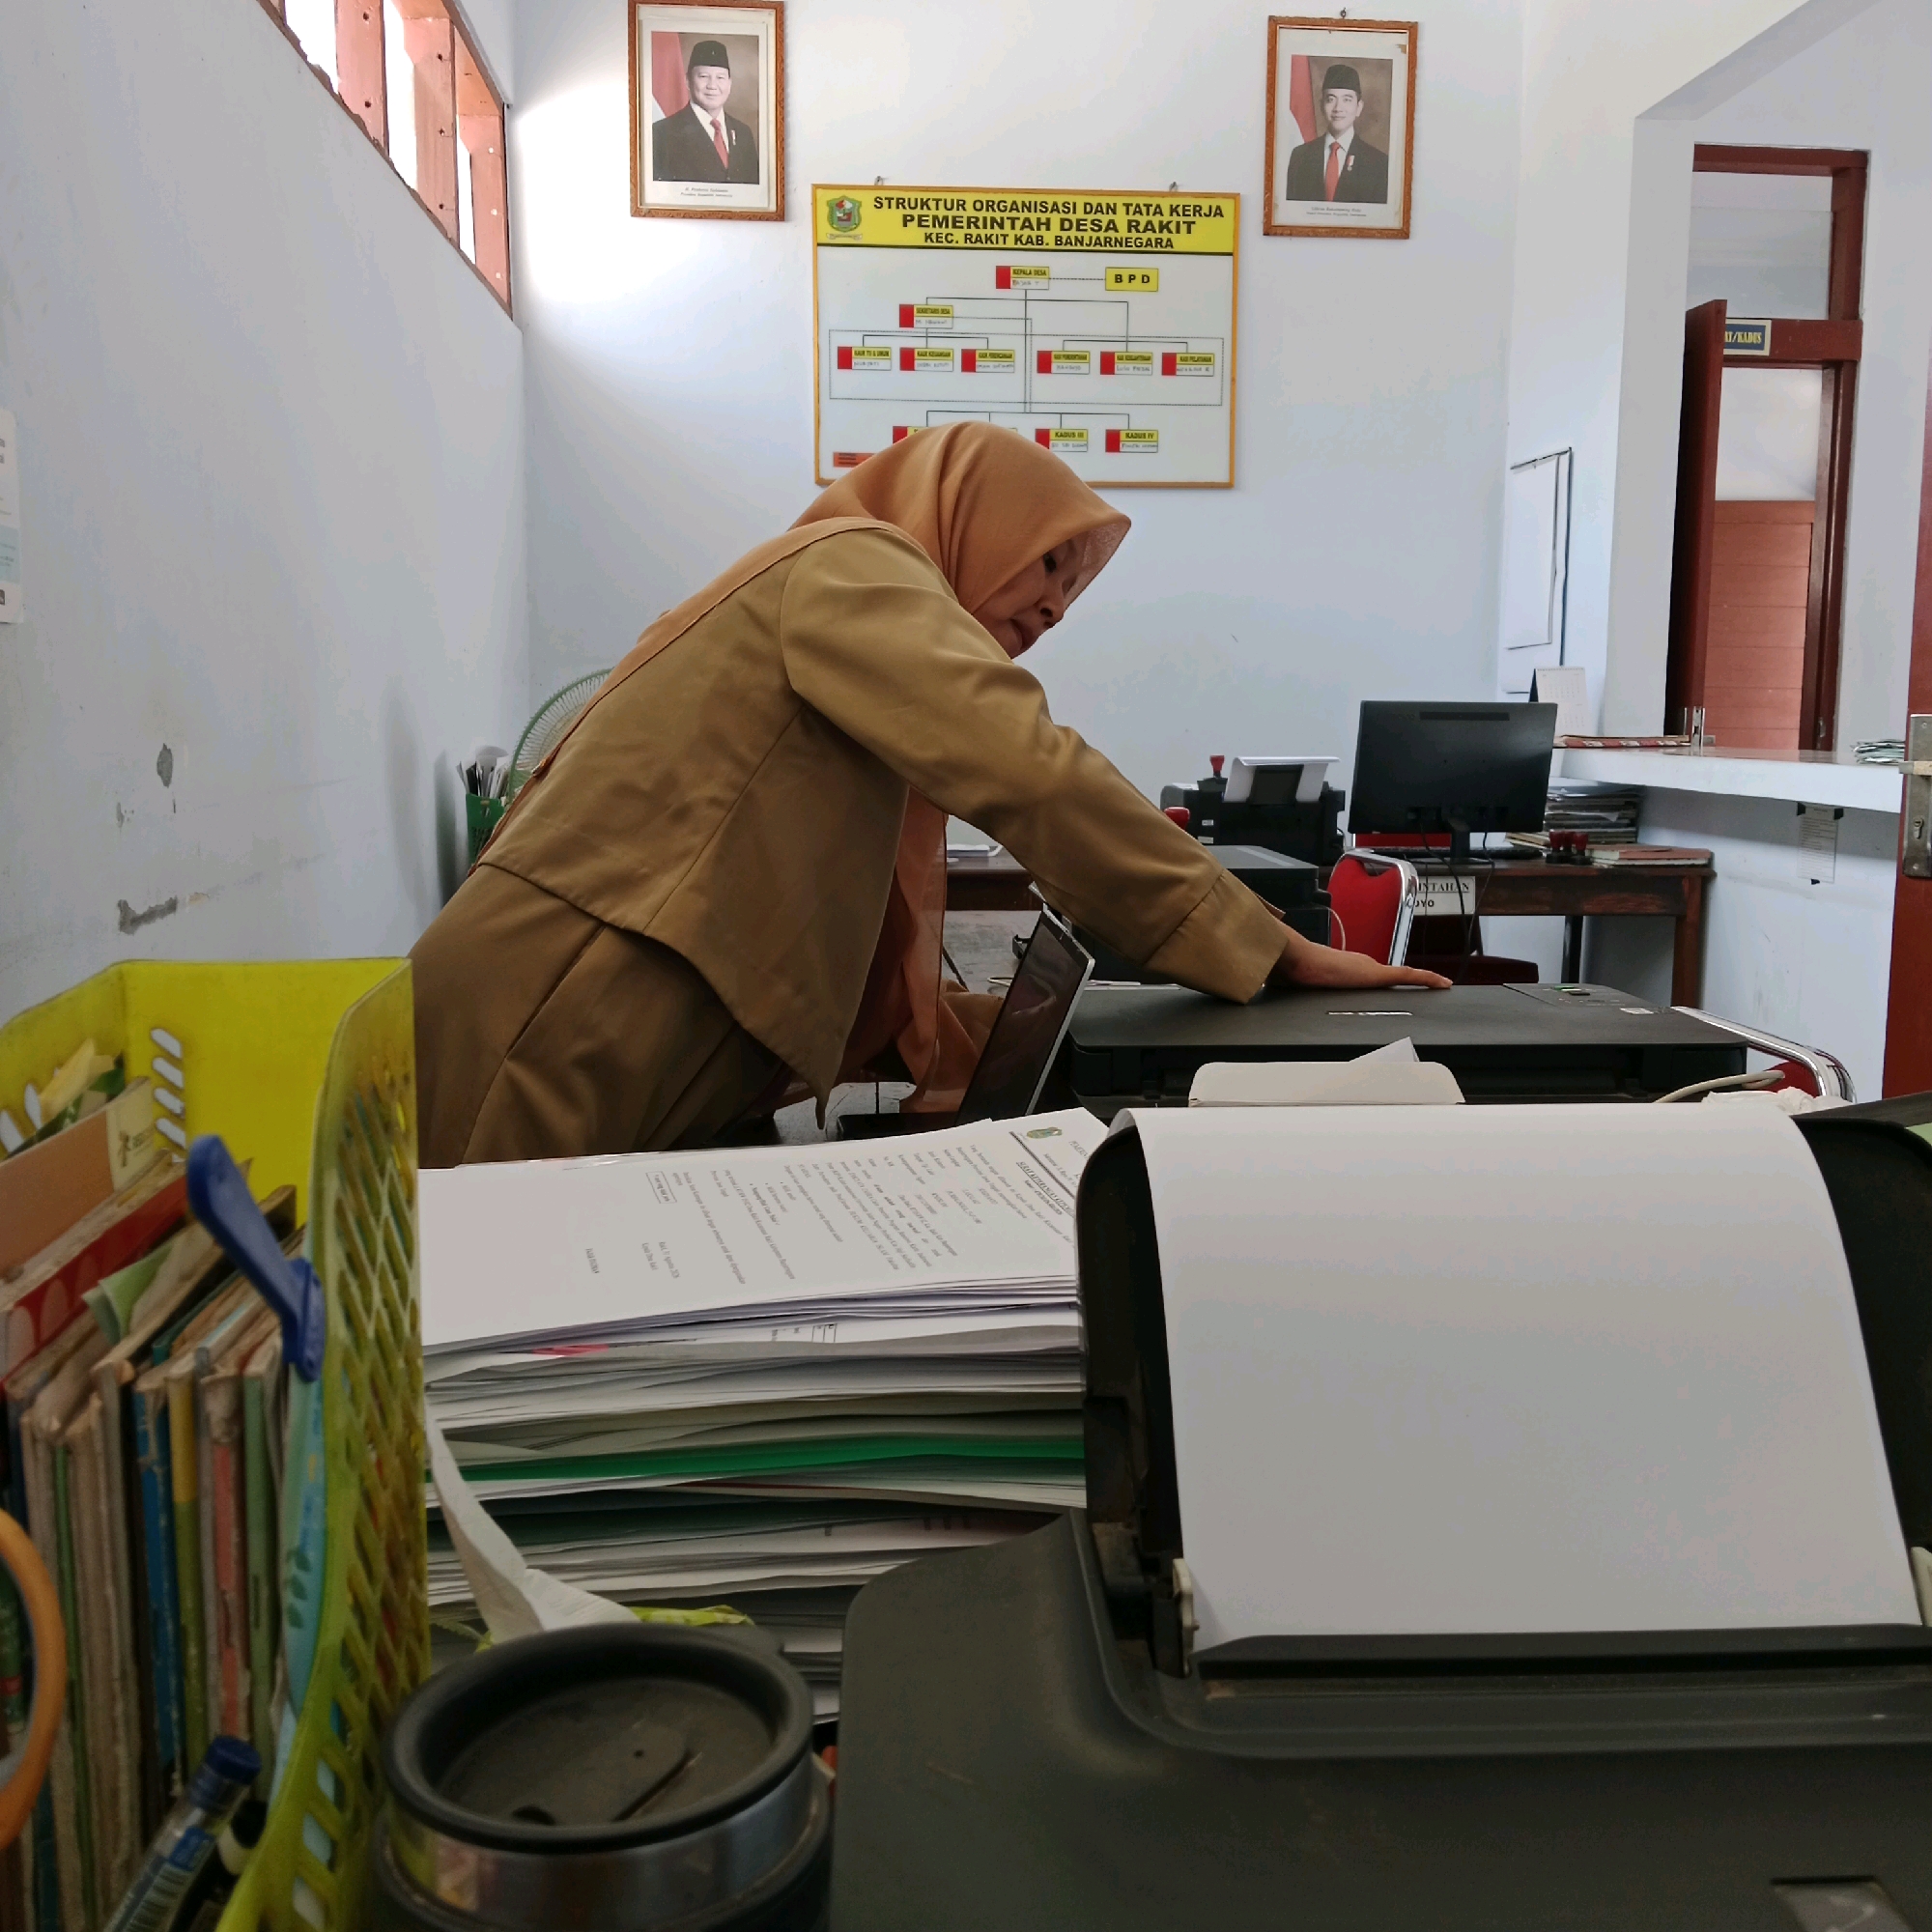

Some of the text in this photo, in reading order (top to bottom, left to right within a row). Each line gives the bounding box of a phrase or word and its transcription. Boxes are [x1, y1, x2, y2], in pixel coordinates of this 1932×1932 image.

[873, 196, 1224, 217] STRUKTUR ORGANISASI DAN TATA KERJA
[902, 213, 1196, 235] PEMERINTAH DESA RAKIT
[924, 232, 1174, 248] KEC. RAKIT KAB. BANJARNEGARA
[1418, 882, 1469, 892] INTAHAN
